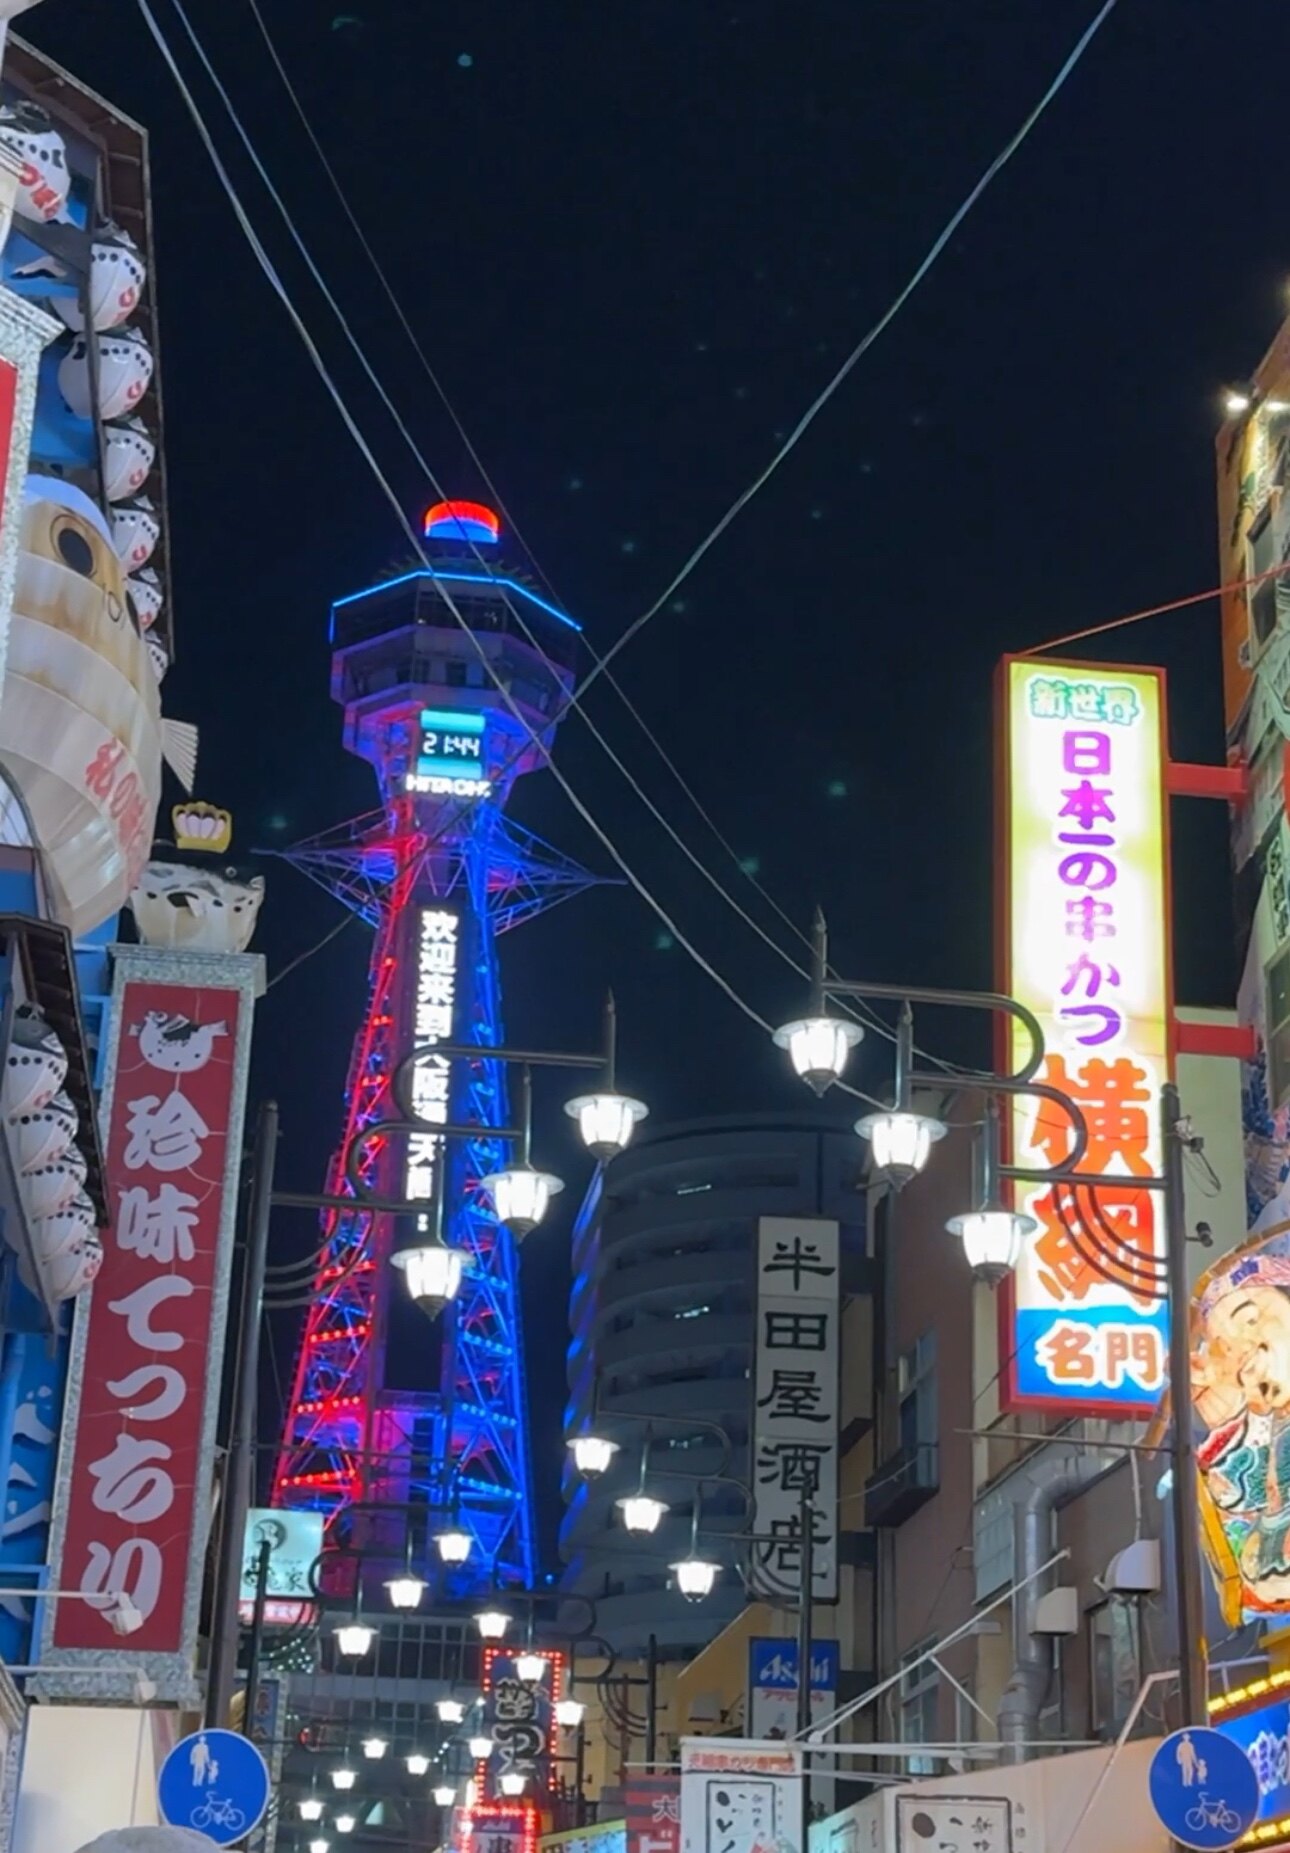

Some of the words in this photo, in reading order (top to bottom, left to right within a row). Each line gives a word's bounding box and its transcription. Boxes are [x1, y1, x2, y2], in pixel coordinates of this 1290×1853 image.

[1031, 679, 1142, 725] 新世界
[423, 732, 480, 757] 21:44
[1057, 730, 1121, 1045] 日本一の串かつ
[1031, 1053, 1156, 1308] 横綱
[1041, 1328, 1162, 1384] 名門
[757, 1235, 836, 1580] 半田屋酒店
[760, 1654, 829, 1686] Ashi
